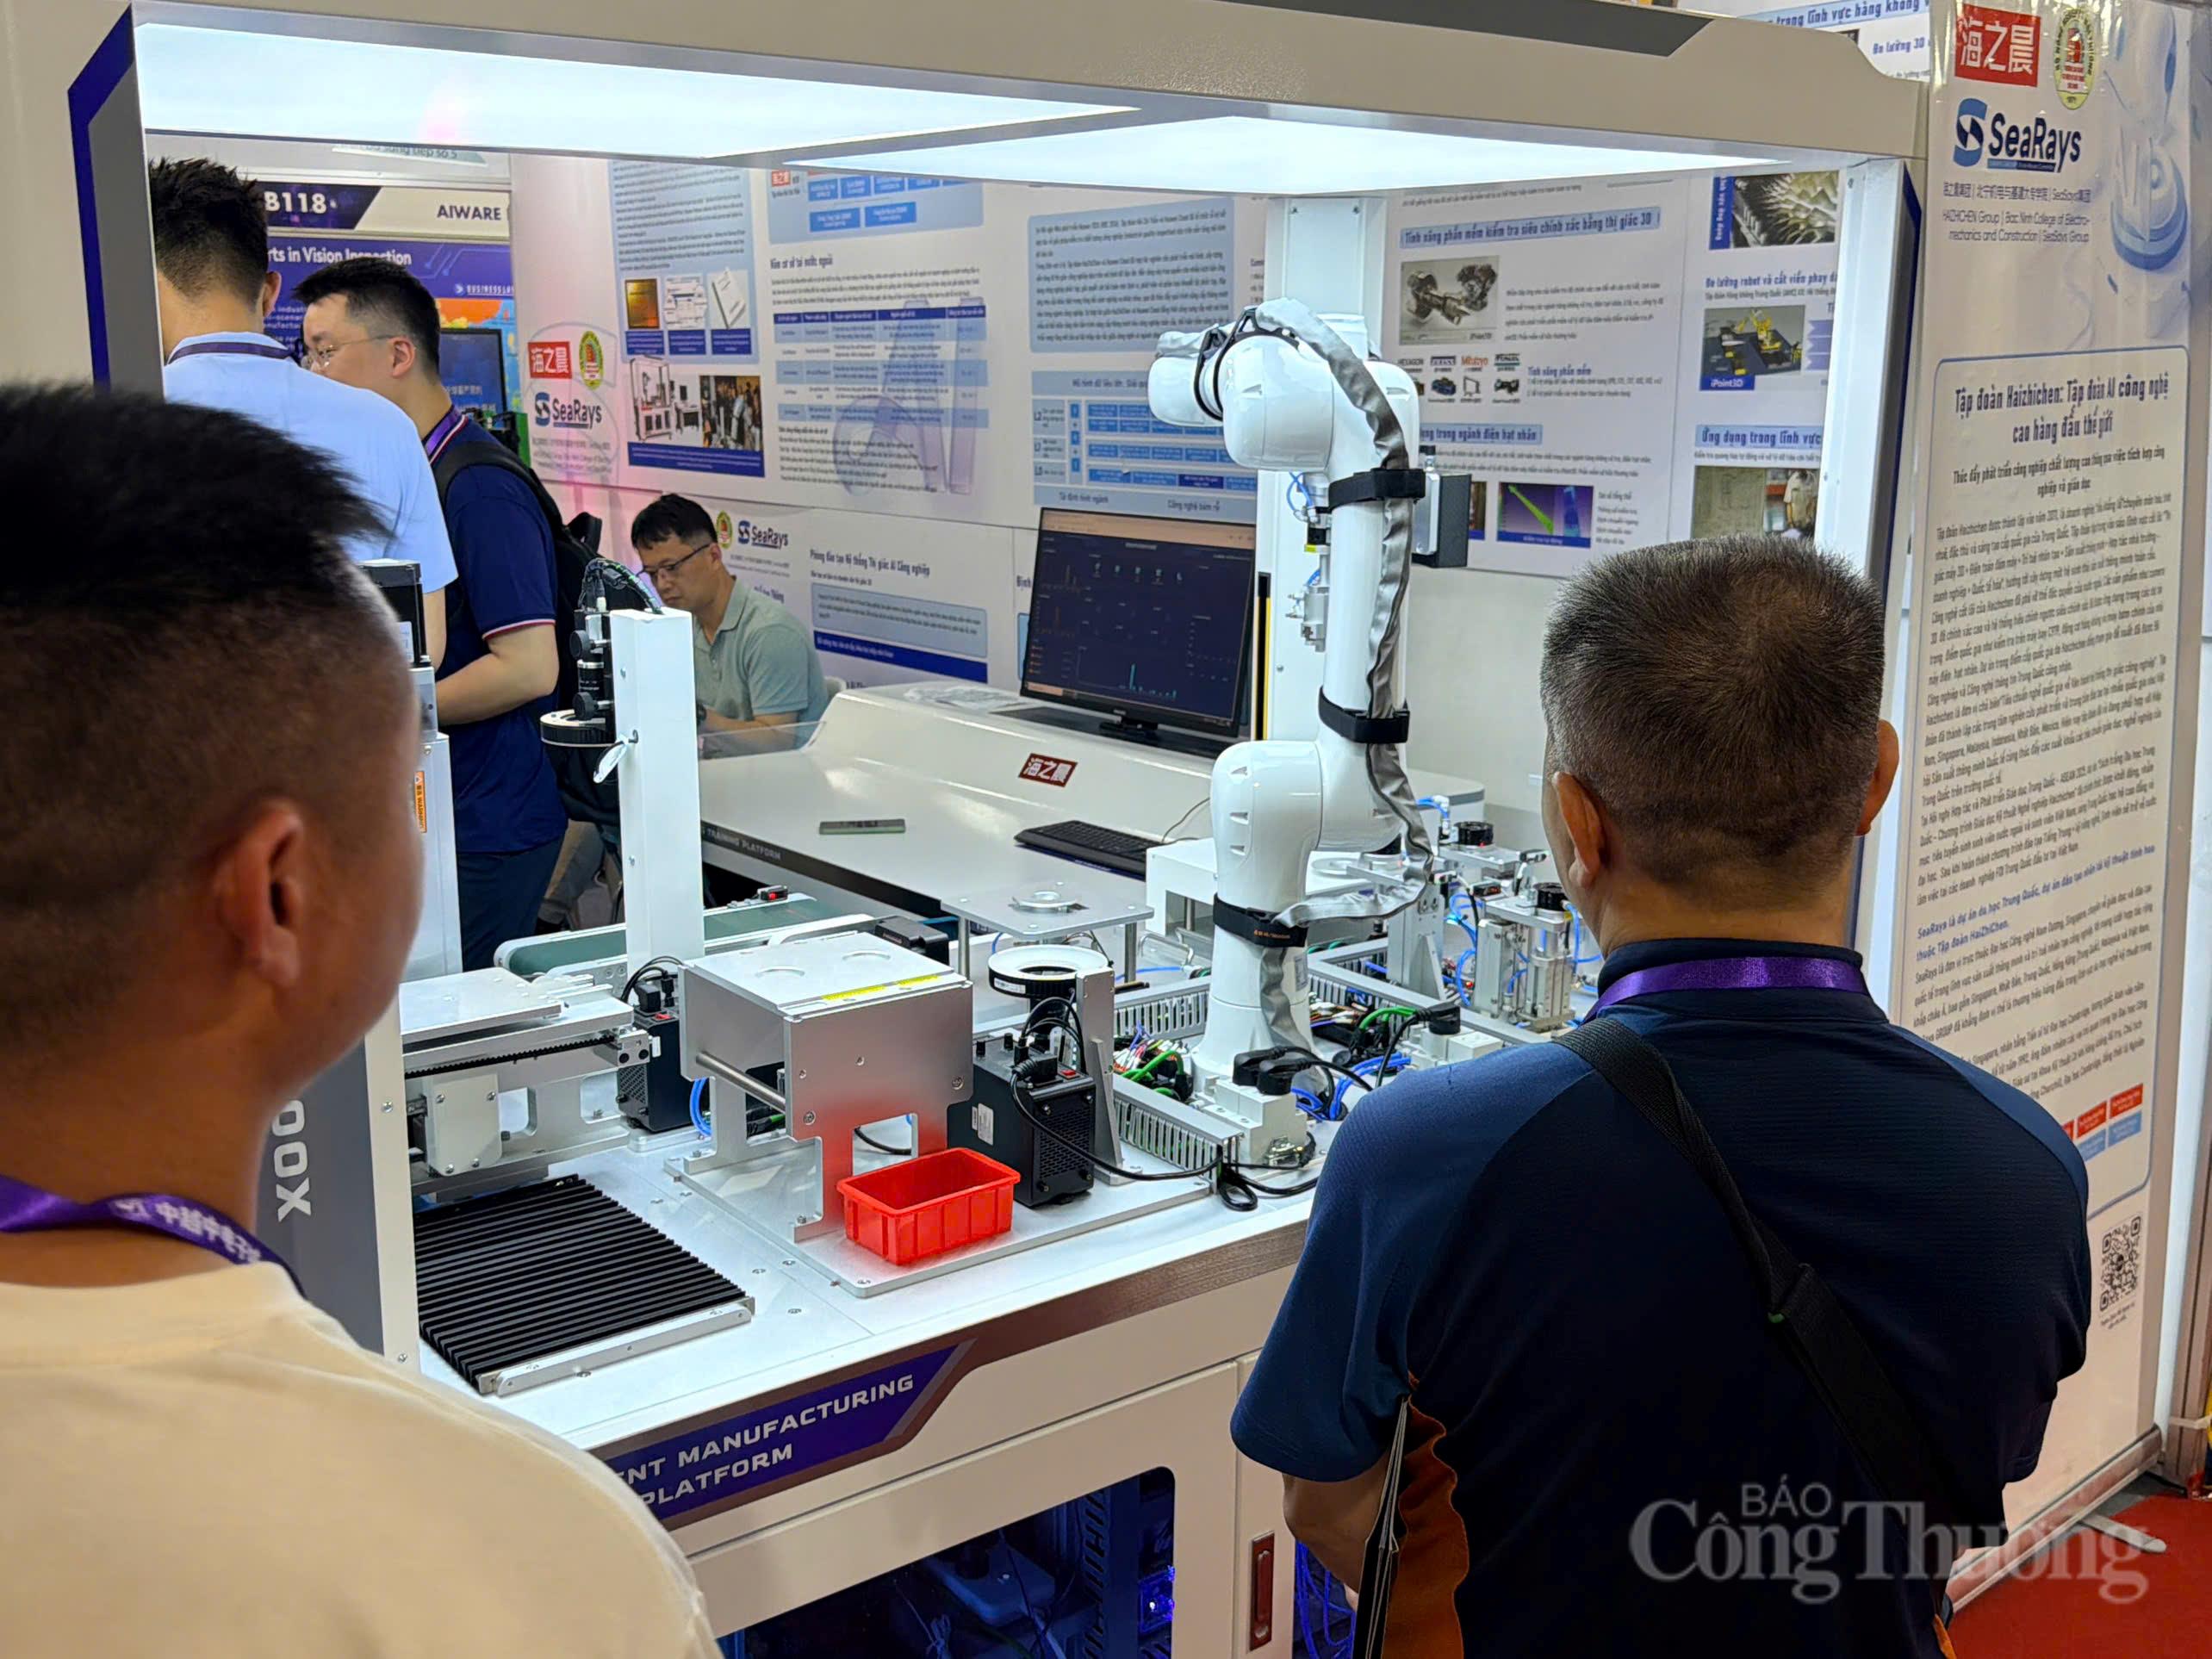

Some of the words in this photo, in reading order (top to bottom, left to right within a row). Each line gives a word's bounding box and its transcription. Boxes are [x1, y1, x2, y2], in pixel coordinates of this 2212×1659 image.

[1989, 112, 2082, 172] SeaRays
[264, 191, 326, 214] B118
[437, 205, 501, 221] AIWARE
[268, 246, 285, 263] rts
[288, 246, 301, 263] in
[302, 246, 343, 264] Vision
[552, 398, 602, 429] SeaRays
[1954, 386, 1973, 419] Tập
[1976, 383, 2003, 411] đoàn
[1724, 430, 1746, 446] dụng
[1750, 432, 1775, 447] trong
[2012, 425, 2029, 443] cao
[2032, 414, 2058, 445] hàng
[751, 525, 788, 550] SeaRays
[618, 1457, 666, 1485] NT
[678, 1374, 913, 1468] MANUFACTURING
[641, 1443, 792, 1505] PLATFORM
